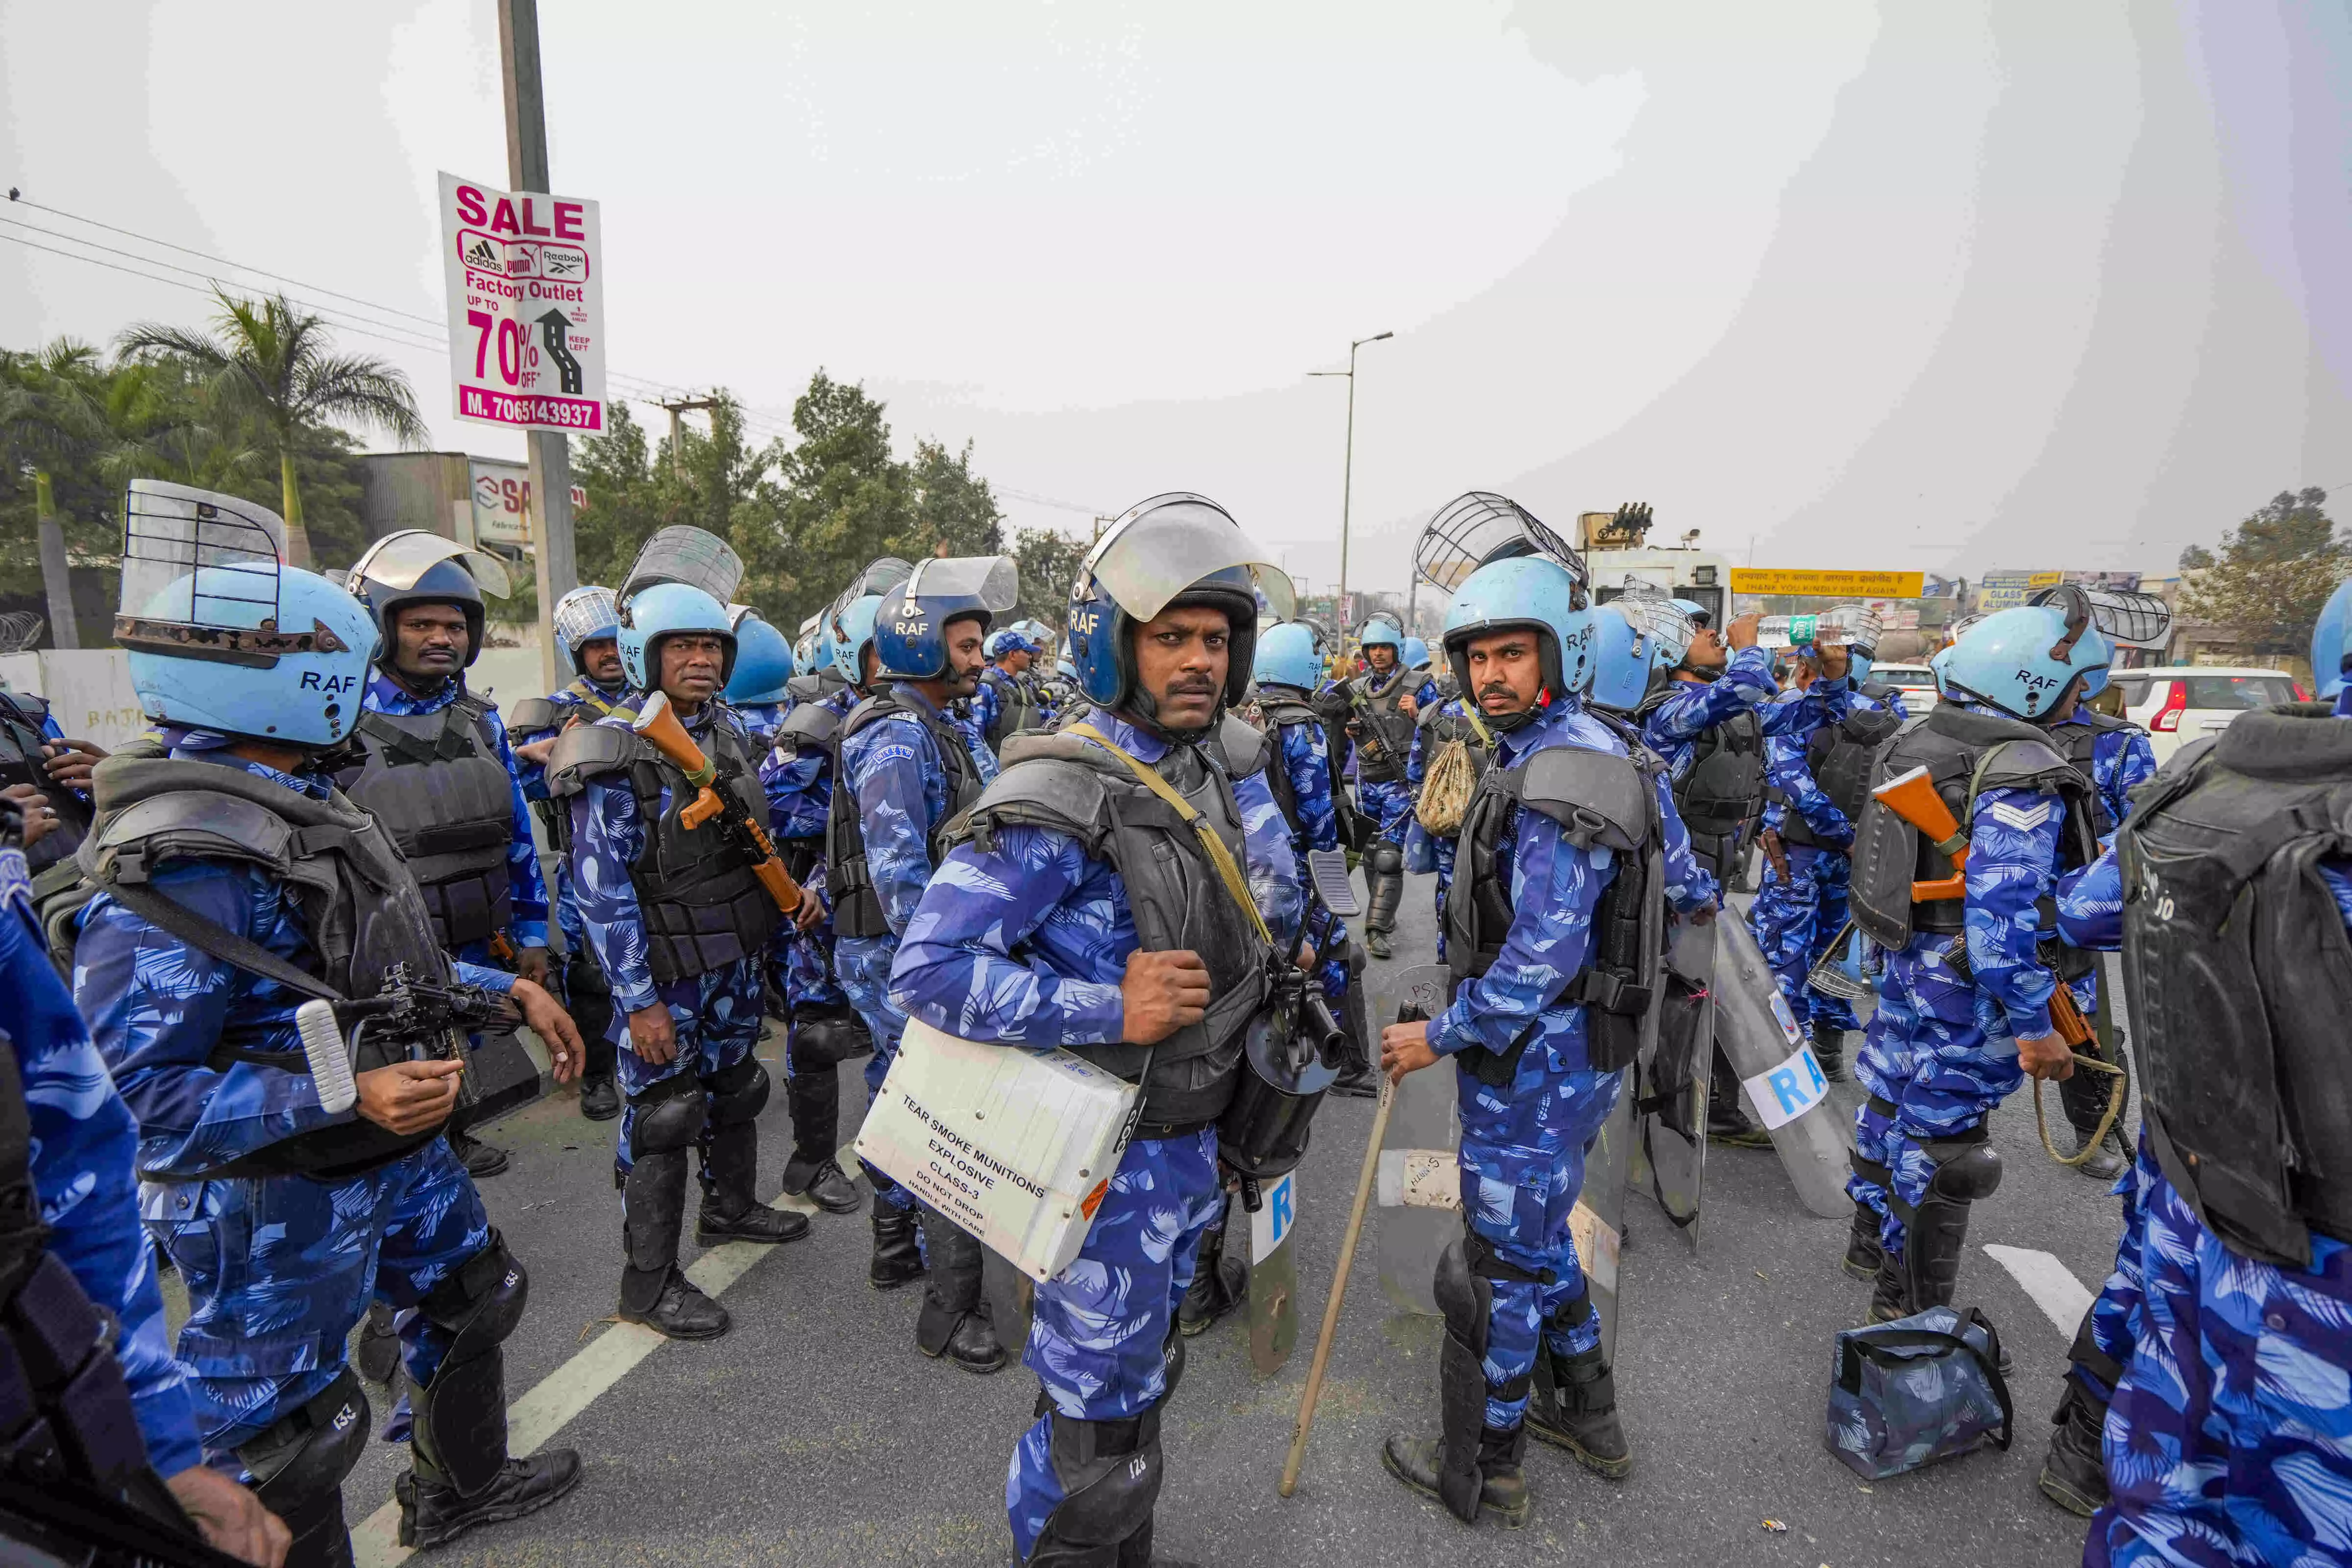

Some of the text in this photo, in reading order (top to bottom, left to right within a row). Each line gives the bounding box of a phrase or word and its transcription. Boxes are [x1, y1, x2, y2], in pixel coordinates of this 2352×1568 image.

[456, 185, 585, 241] SALE
[465, 254, 503, 272] adidas
[507, 259, 530, 273] PUMA
[543, 250, 584, 264] Reebok
[466, 270, 584, 302] Factory Outlet
[467, 294, 499, 312] UP TO
[569, 336, 590, 344] KEEP
[569, 343, 588, 352] LEFT
[467, 392, 592, 427] M. 7065143937
[1991, 590, 2022, 598] GLASS
[895, 622, 929, 636] RAF
[1070, 610, 1099, 635] RAF
[1566, 623, 1596, 651] RAF
[620, 642, 640, 658] RAF
[835, 648, 855, 660] RAF
[300, 671, 357, 693] RAF
[2014, 669, 2058, 689] RAF
[903, 1094, 1046, 1200] TEAR SMOKE MUNITIONS
[928, 1138, 995, 1190] EXPLOSIVE
[930, 1161, 980, 1200] CLASS-3
[908, 1179, 985, 1237] HANDLE WITH CARE
[916, 1170, 984, 1221] DO NOT DROP
[1272, 1176, 1293, 1243] R
[333, 1403, 357, 1430] 133
[1129, 1454, 1147, 1479] 126
